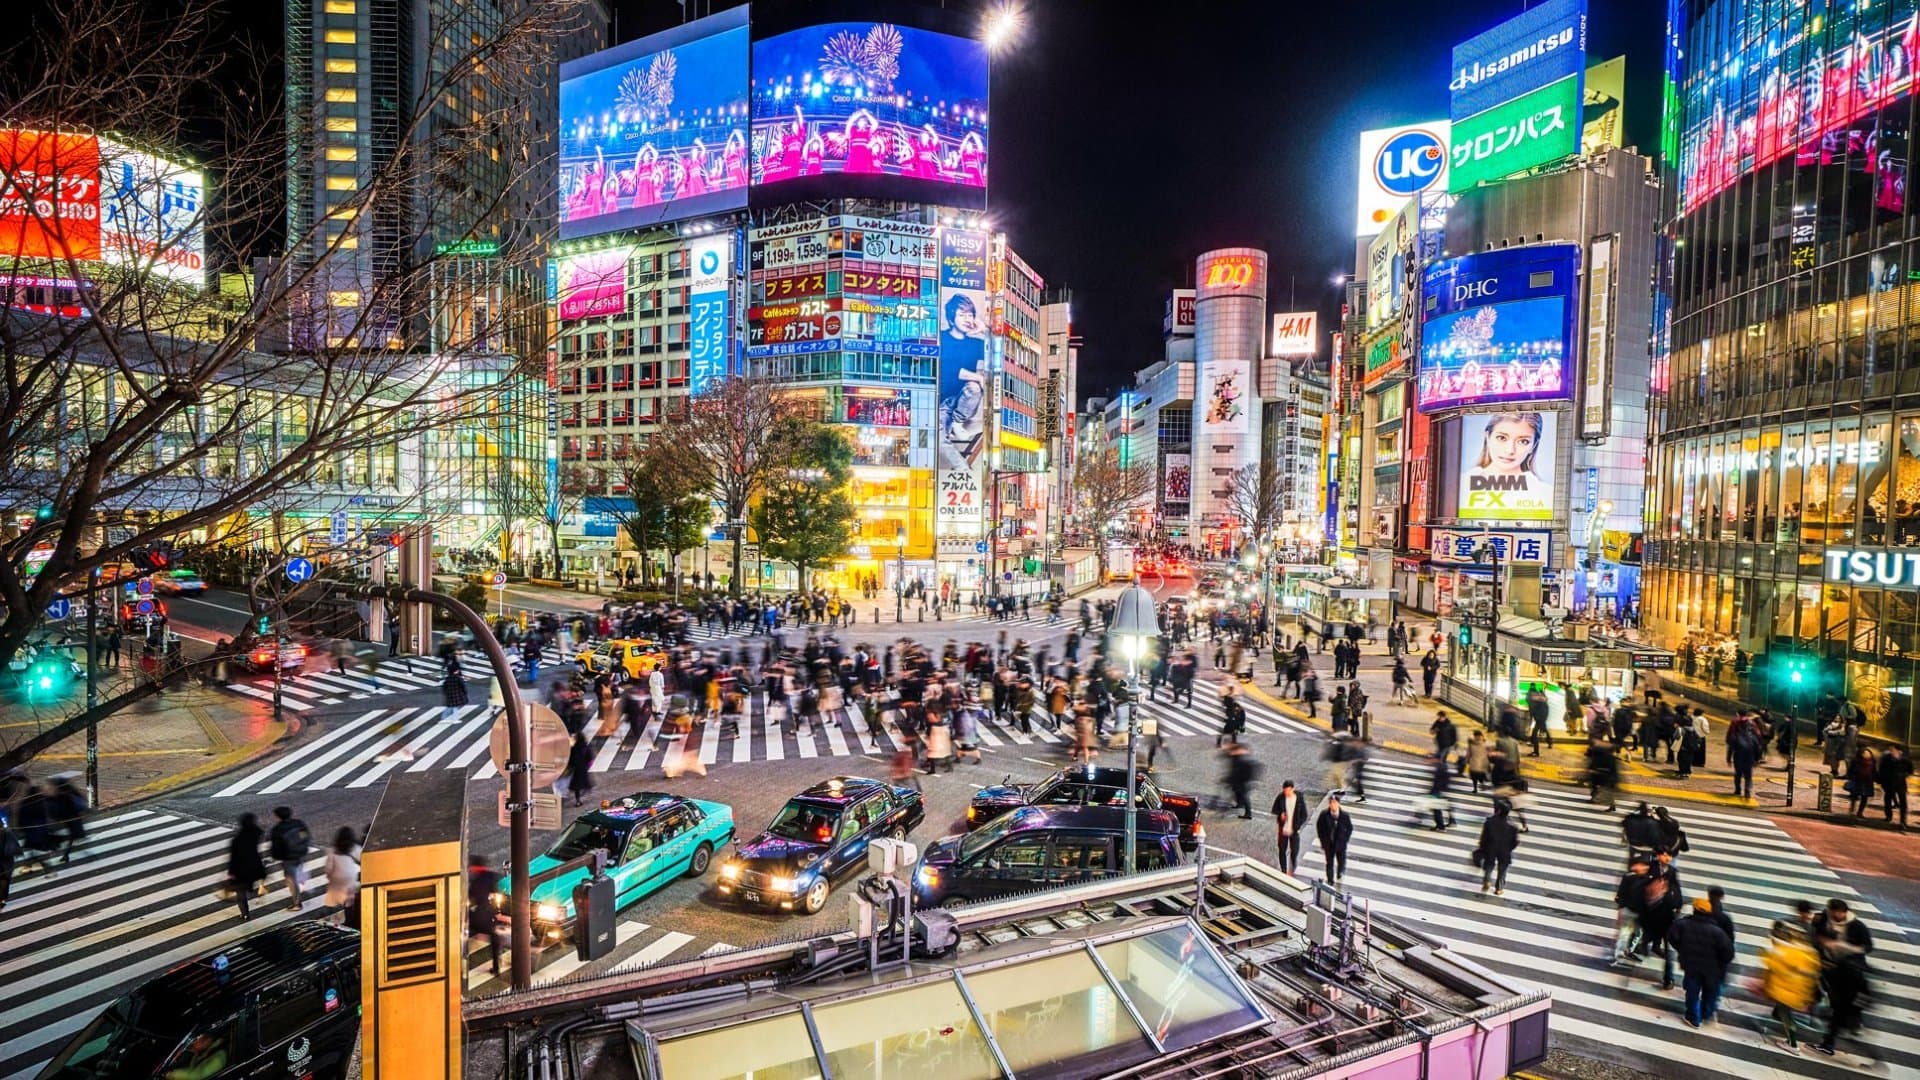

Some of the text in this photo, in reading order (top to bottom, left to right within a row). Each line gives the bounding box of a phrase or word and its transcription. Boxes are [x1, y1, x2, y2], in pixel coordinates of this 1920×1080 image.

[1449, 27, 1573, 90] Hisamitsu
[1452, 104, 1565, 168] サロンパス
[1383, 145, 1440, 181] UC
[757, 220, 822, 239] しゃぶしゃぶバイキング
[856, 218, 936, 235] しゃぶしゃぶバイキング
[889, 239, 936, 259] しゃぶ葉
[946, 234, 982, 252] Nissy
[752, 251, 763, 262] 9F
[952, 267, 977, 276] ツアー
[844, 273, 918, 294] コンタクト
[1455, 278, 1498, 302] DHC
[800, 300, 830, 316] ガスト
[896, 304, 930, 319] ガスト
[751, 328, 764, 340] 7F
[784, 321, 820, 340] ガスト
[694, 303, 709, 388] アイシティ
[1784, 440, 1883, 469] COFFEE
[947, 472, 972, 481] ベスト
[1470, 475, 1528, 491] DMM
[941, 481, 977, 491] アルバム
[1468, 491, 1505, 507] FX
[940, 506, 979, 515] ON SALE
